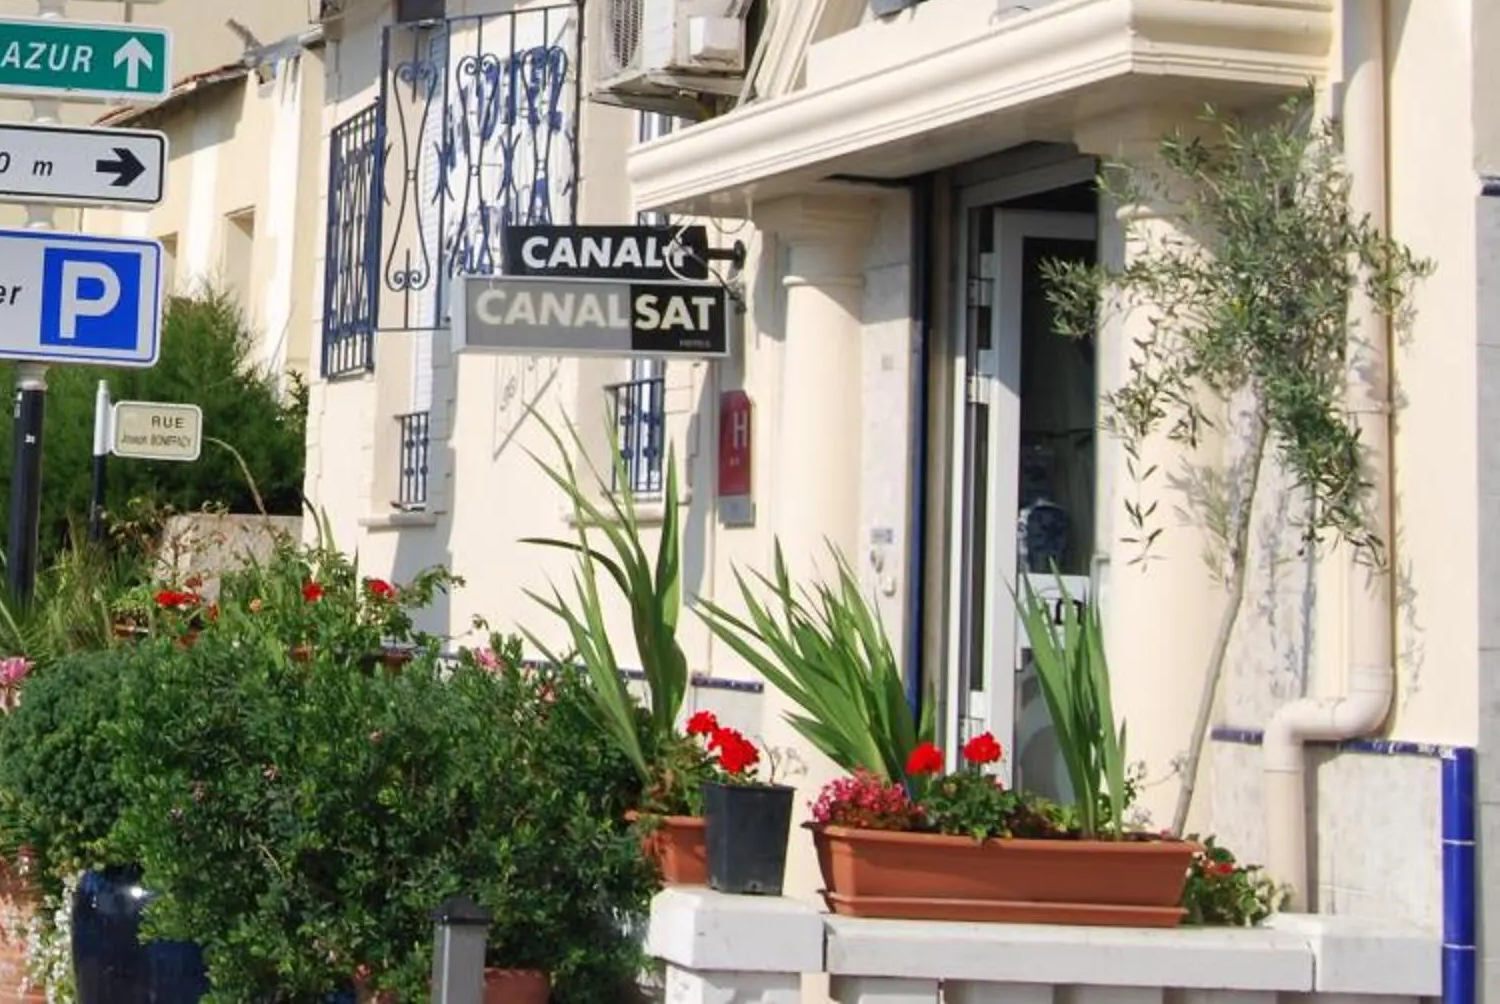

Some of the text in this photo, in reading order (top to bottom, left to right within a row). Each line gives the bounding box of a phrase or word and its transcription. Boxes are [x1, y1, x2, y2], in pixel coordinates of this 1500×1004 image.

[32, 159, 53, 177] m
[59, 259, 121, 340] P
[151, 415, 185, 429] RUE
[733, 411, 747, 450] H
